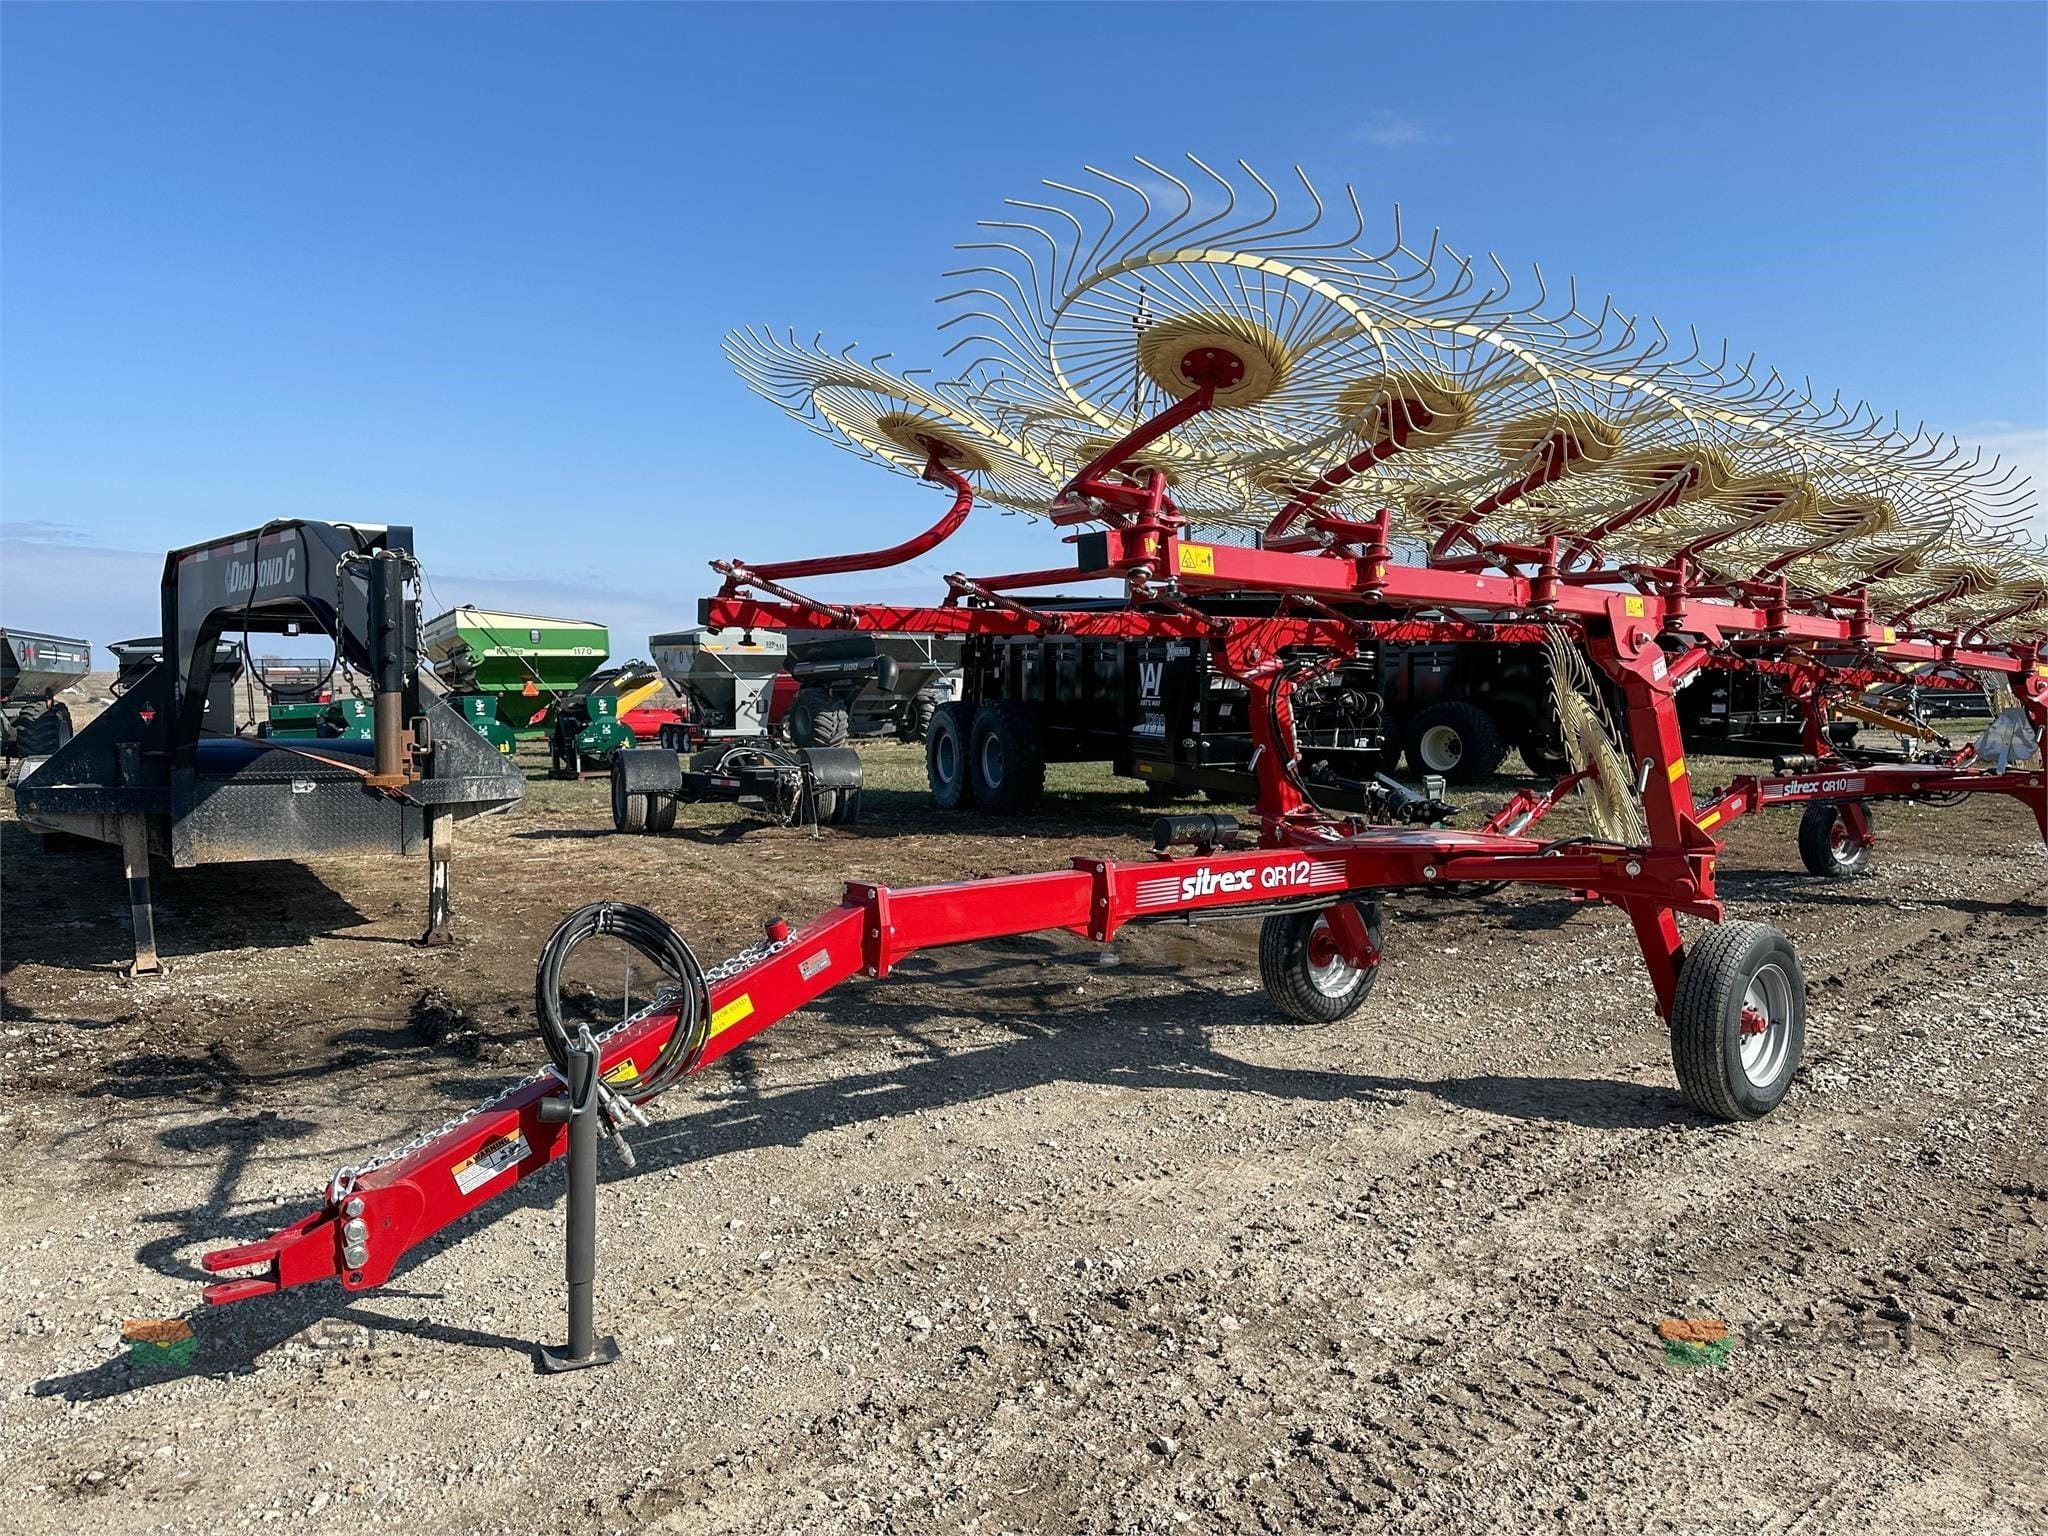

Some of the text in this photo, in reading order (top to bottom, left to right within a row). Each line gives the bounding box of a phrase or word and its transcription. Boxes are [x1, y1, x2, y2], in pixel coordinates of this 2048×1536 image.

[285, 547, 296, 583] C
[1784, 778, 1847, 797] sitrex QR10
[1181, 860, 1311, 901] sitrex QR12
[473, 1136, 510, 1163] WARNING
